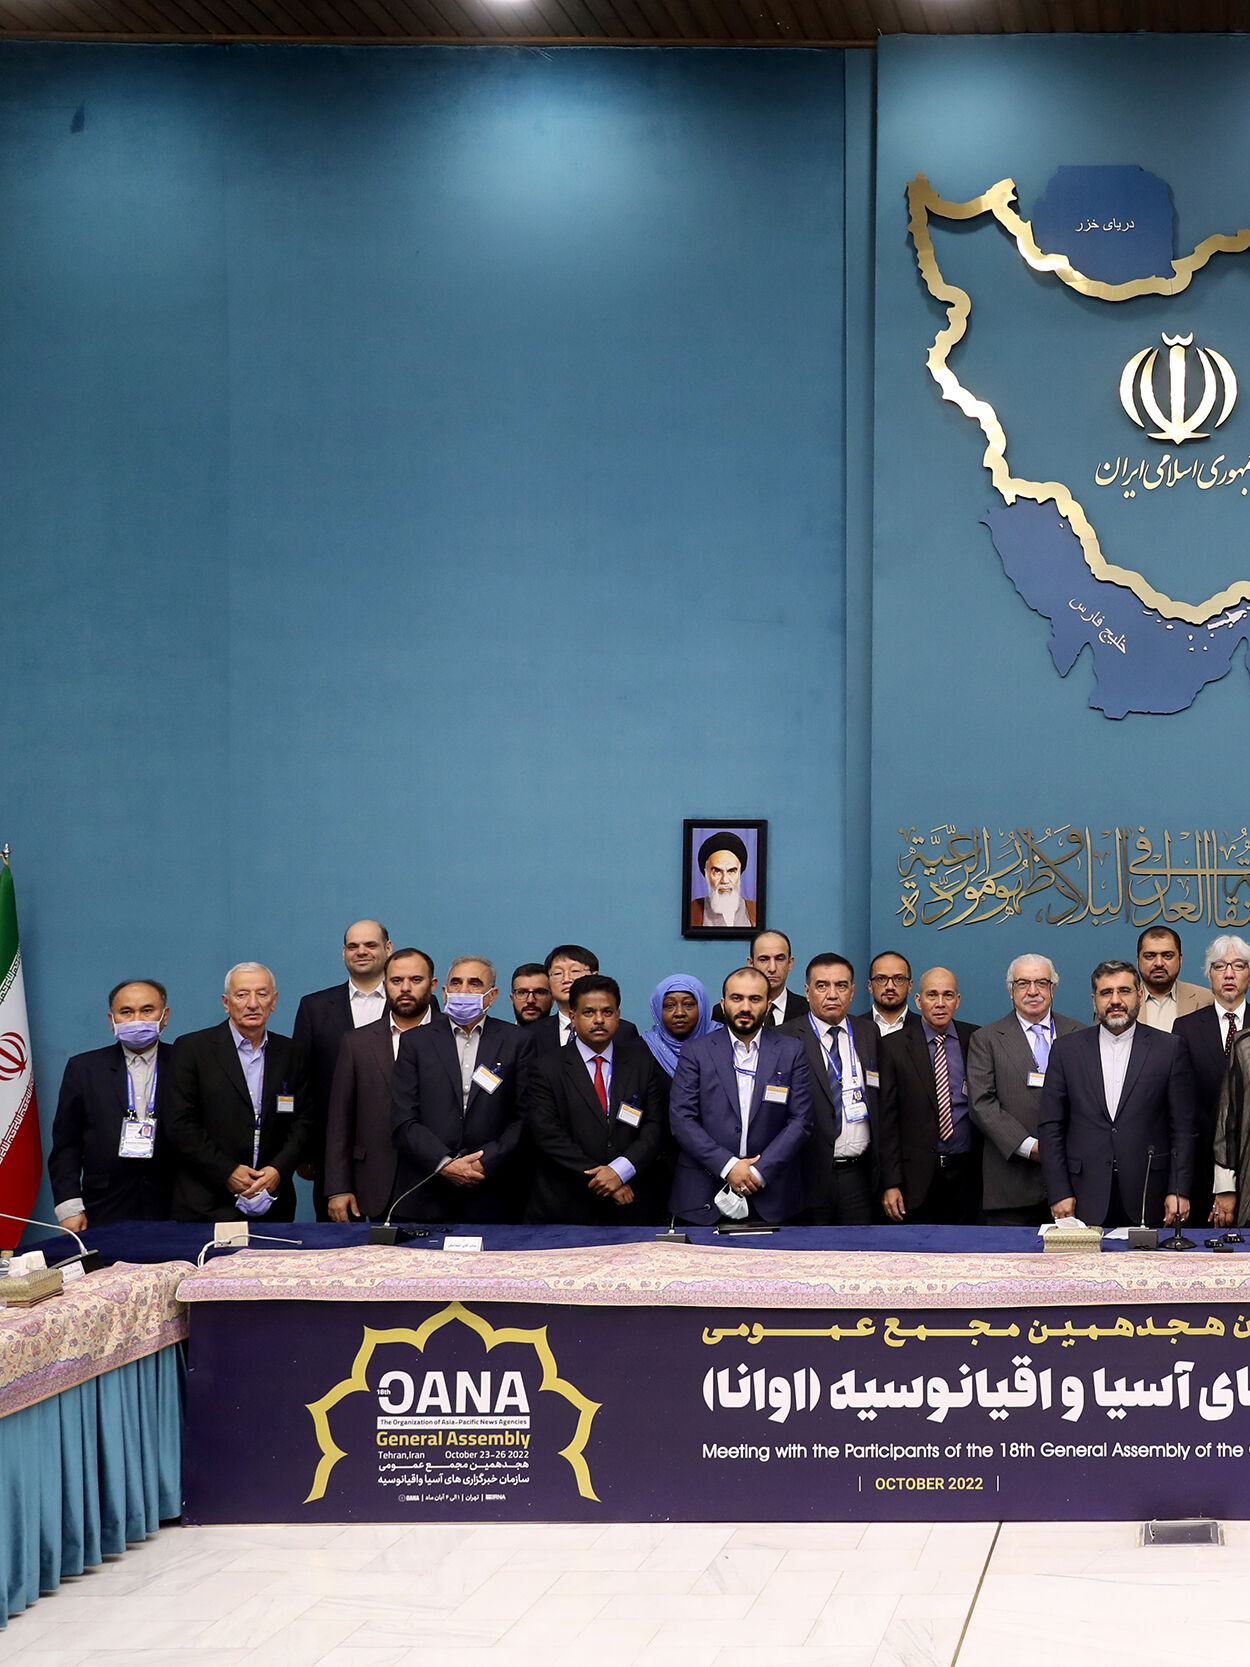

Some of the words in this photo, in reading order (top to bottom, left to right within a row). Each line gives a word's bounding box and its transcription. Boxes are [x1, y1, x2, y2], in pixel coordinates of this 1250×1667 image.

[1075, 219, 1100, 232] خزر
[1102, 218, 1135, 232] دریای
[1094, 456, 1144, 499] ایران
[1143, 453, 1198, 490] اسلامی
[1068, 596, 1106, 629] فارس
[1098, 628, 1128, 655] خلیج
[702, 1318, 875, 1344] عمومی
[884, 1318, 1020, 1347] مجمع
[1028, 1317, 1225, 1347] هجدهمین
[378, 1370, 531, 1414] OANA
[703, 1363, 820, 1423] (اوانا)
[831, 1355, 1051, 1423] اقیانوسیه
[1093, 1361, 1194, 1419] آسیا
[1062, 1376, 1084, 1422] و
[377, 1431, 442, 1445] General
[447, 1431, 530, 1449] Assembly
[378, 1451, 425, 1459] Tehran,Iran
[703, 1444, 769, 1462] Meeting
[775, 1444, 807, 1458] with
[812, 1444, 839, 1458] the
[845, 1444, 939, 1460] Participants
[945, 1443, 961, 1457] of
[966, 1443, 993, 1457] the
[1001, 1443, 1034, 1457] 18th
[1041, 1443, 1106, 1457] General
[1112, 1443, 1190, 1460] Assembly
[1195, 1443, 1211, 1457] of
[1217, 1443, 1243, 1457] the
[379, 1462, 424, 1471] عمومی
[426, 1463, 468, 1472] مجمع
[469, 1461, 529, 1470] هجدهمین
[378, 1474, 423, 1486] واقیانوسیه
[425, 1473, 443, 1485] آسیا
[444, 1474, 461, 1485] های
[463, 1473, 497, 1486] خبرگزاری
[499, 1474, 529, 1485] سازمان
[876, 1478, 944, 1490] OCTOBER
[948, 1478, 983, 1489] 2022
